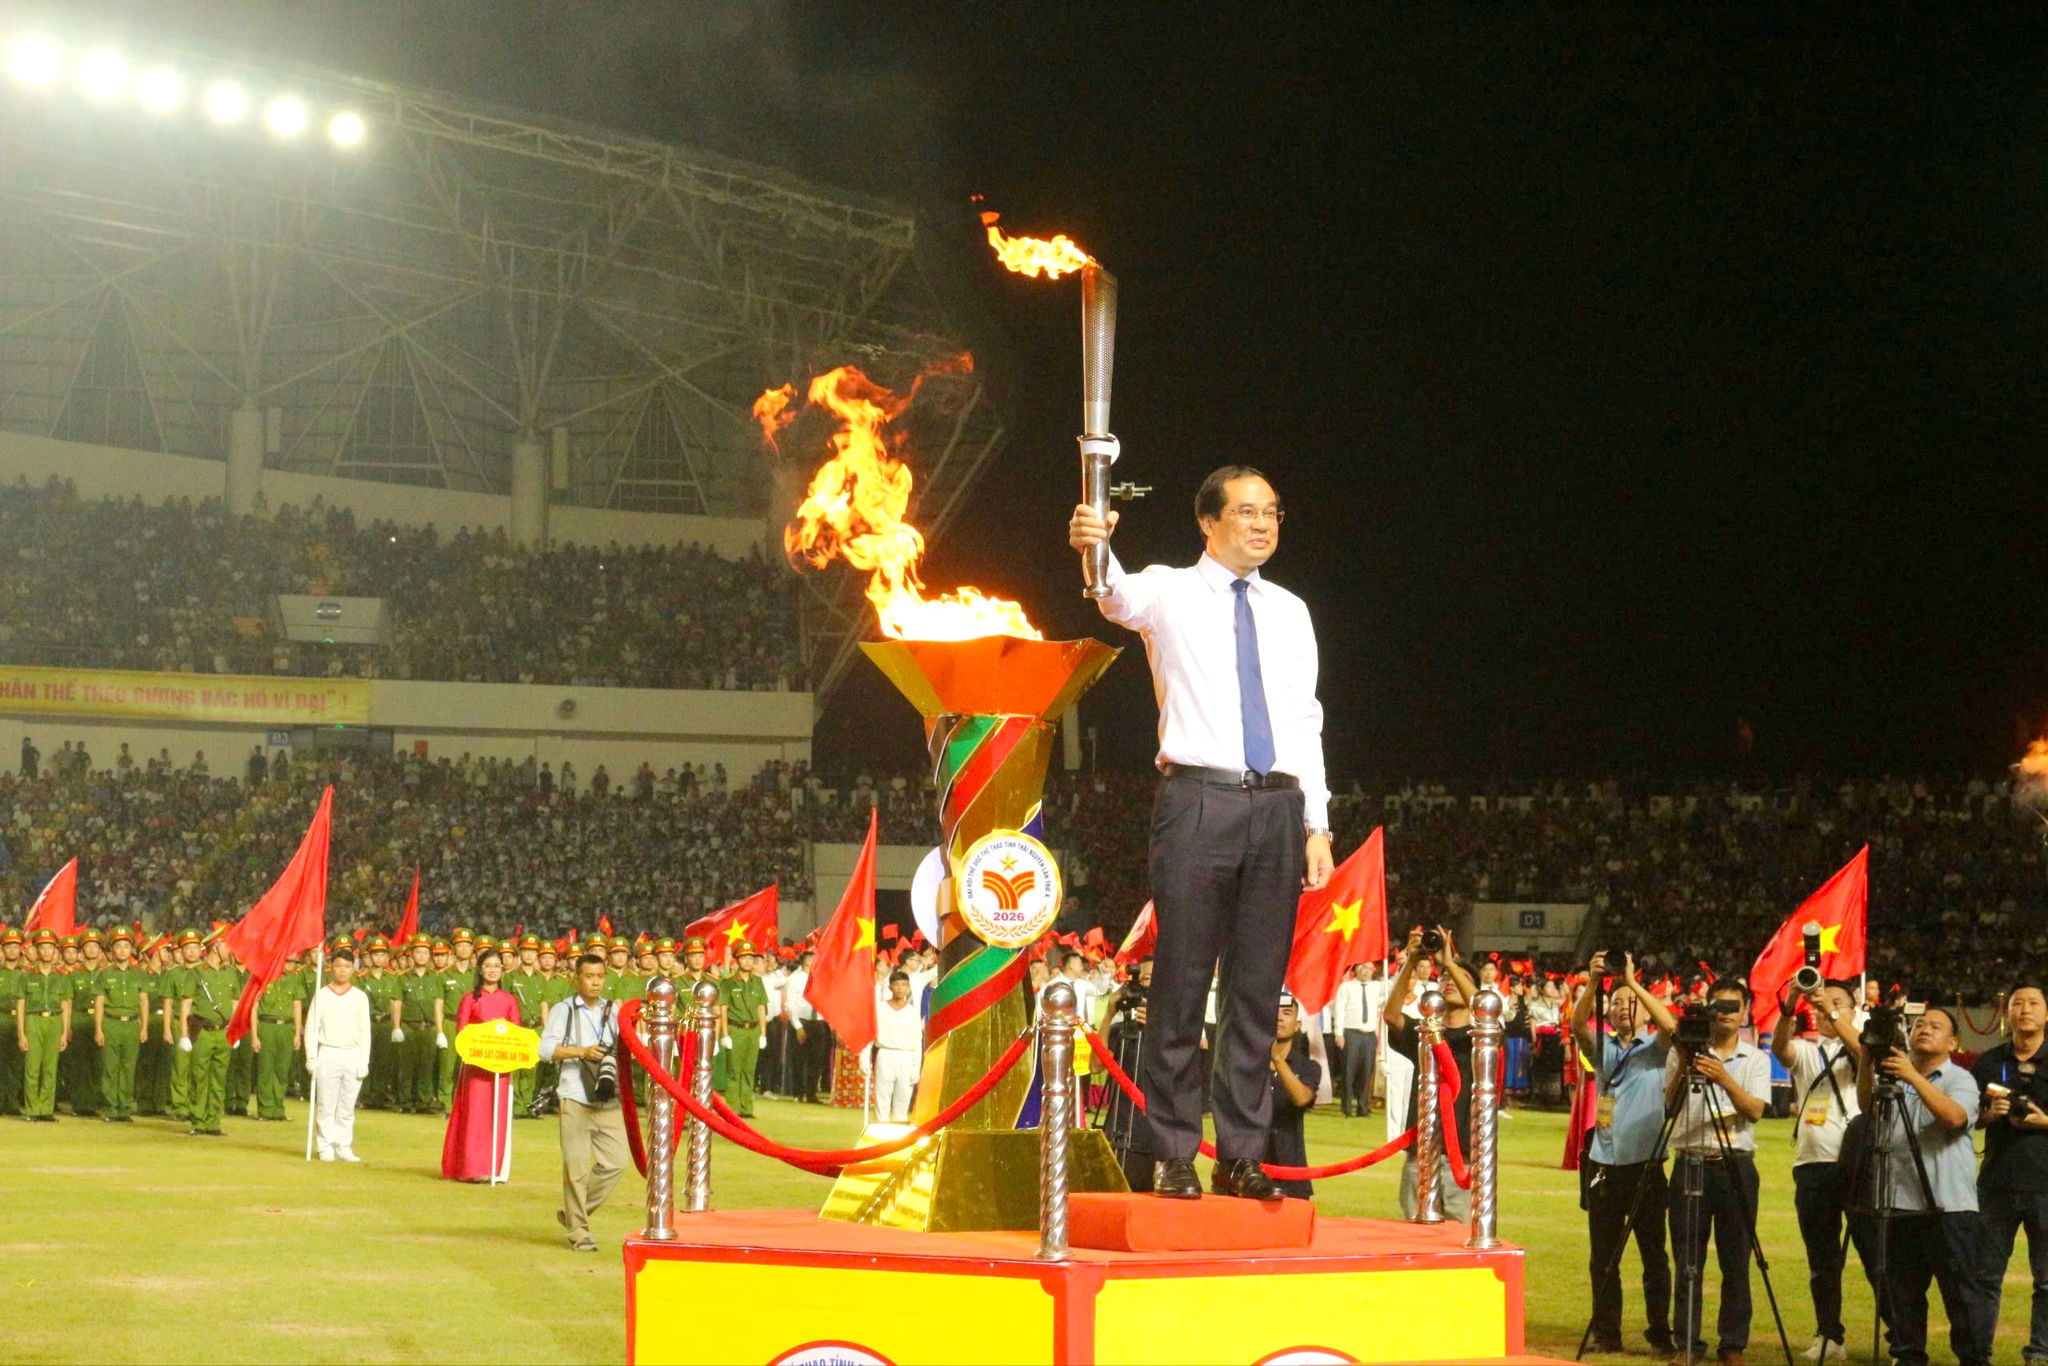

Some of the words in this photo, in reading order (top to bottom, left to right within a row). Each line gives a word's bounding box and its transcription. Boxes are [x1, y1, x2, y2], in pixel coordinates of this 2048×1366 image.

[82, 684, 126, 704] THEO
[993, 912, 1025, 922] 2026
[1524, 914, 1541, 926] D1
